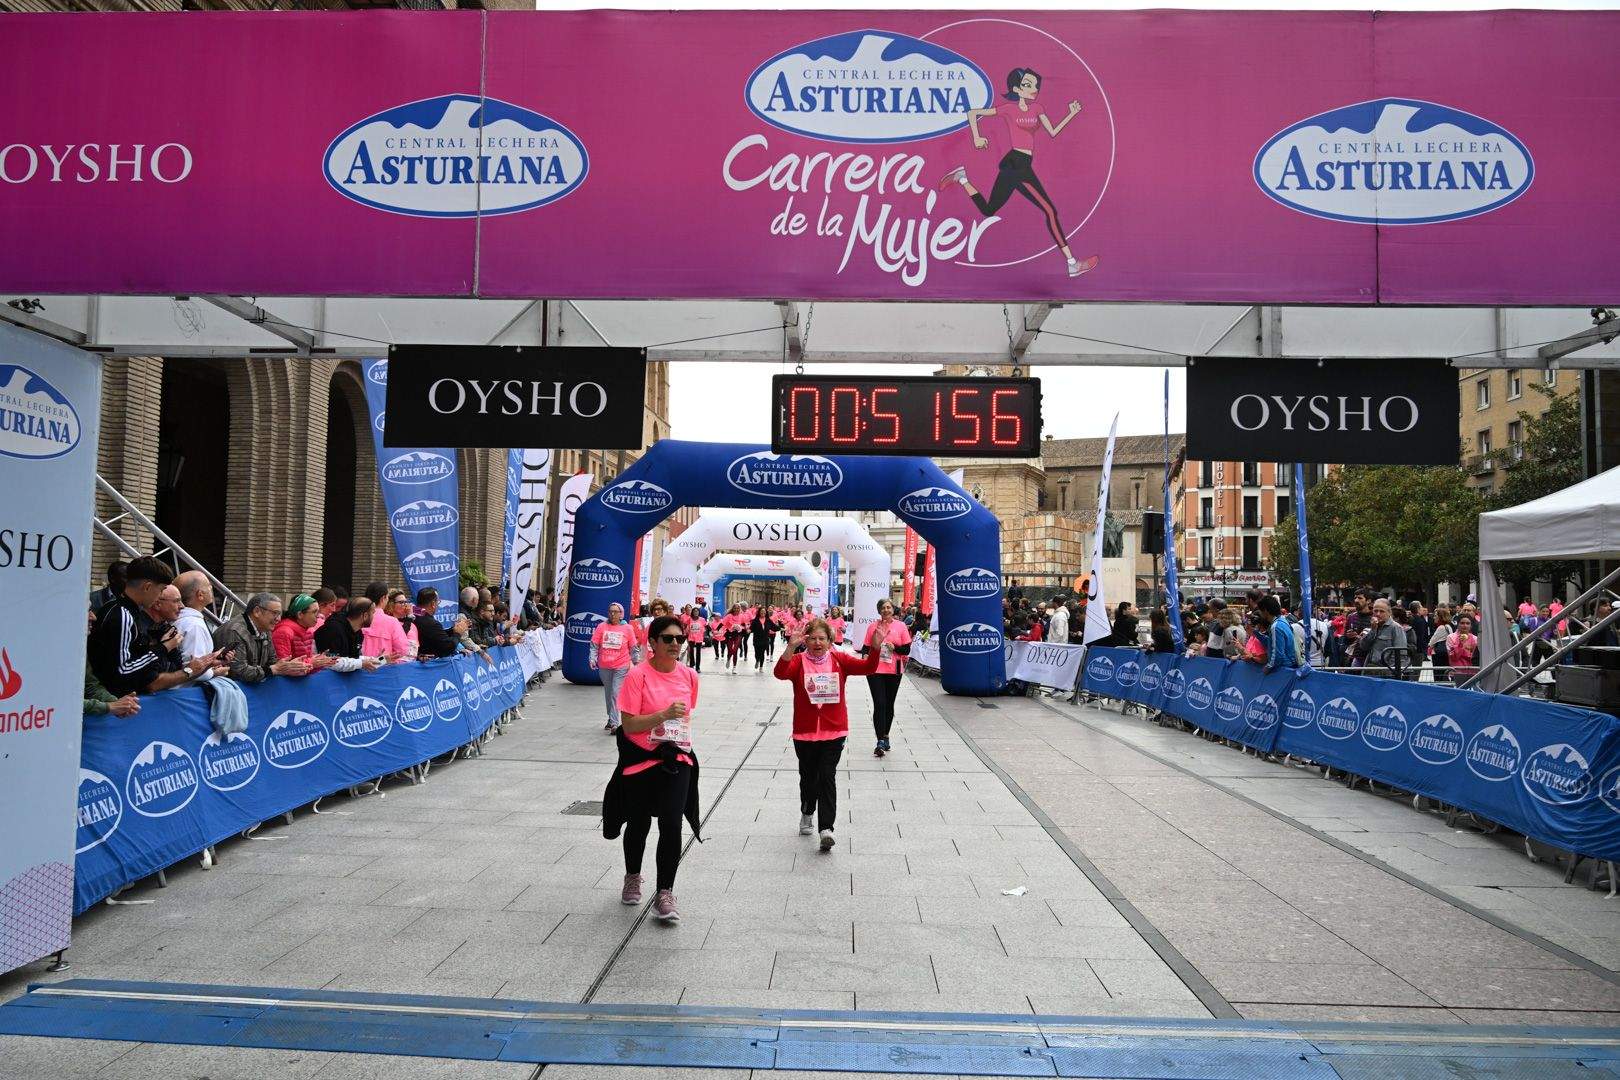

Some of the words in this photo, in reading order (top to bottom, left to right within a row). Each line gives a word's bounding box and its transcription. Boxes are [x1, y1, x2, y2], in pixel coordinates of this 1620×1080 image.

[803, 69, 880, 81] CENTRAL
[888, 71, 966, 81] LECHERA
[763, 71, 973, 114] ASTURIANA
[385, 137, 466, 149] CENTRAL
[475, 137, 560, 149] LECHERA
[1319, 142, 1405, 154] CENTRAL
[1414, 142, 1504, 153] LECHERA
[0, 143, 193, 184] OYSHO
[342, 140, 568, 186] ASTURIANA
[722, 134, 926, 194] Carrera
[1275, 145, 1514, 191] ASTURIANA
[770, 196, 808, 236] de
[816, 196, 844, 237] la
[837, 190, 1002, 287] Mujer
[428, 378, 608, 418] OYSHO
[27, 401, 69, 419] LECHERA
[1230, 394, 1419, 433] OYSHO
[736, 463, 835, 486] ASTURIANA
[605, 491, 667, 506] ASTURIANA
[904, 500, 967, 512] ASTURIANA
[733, 522, 823, 541] OYSHO
[678, 541, 707, 549] OYSHO
[571, 567, 620, 583] ASTURIANA
[664, 576, 691, 584] OYSHO
[948, 580, 998, 592] ASTURIANA
[949, 635, 999, 646] ASTURIANA
[1027, 645, 1069, 667] OYSHO
[339, 716, 390, 739] ASTURIANA
[1319, 709, 1356, 732] ASTURIANA
[1363, 719, 1402, 742] ASTURIANA
[269, 731, 326, 760] ASTURIANA
[1412, 729, 1458, 755] ASTURIANA
[204, 750, 258, 780] ASTURIANA
[134, 768, 196, 807] ASTURIANA
